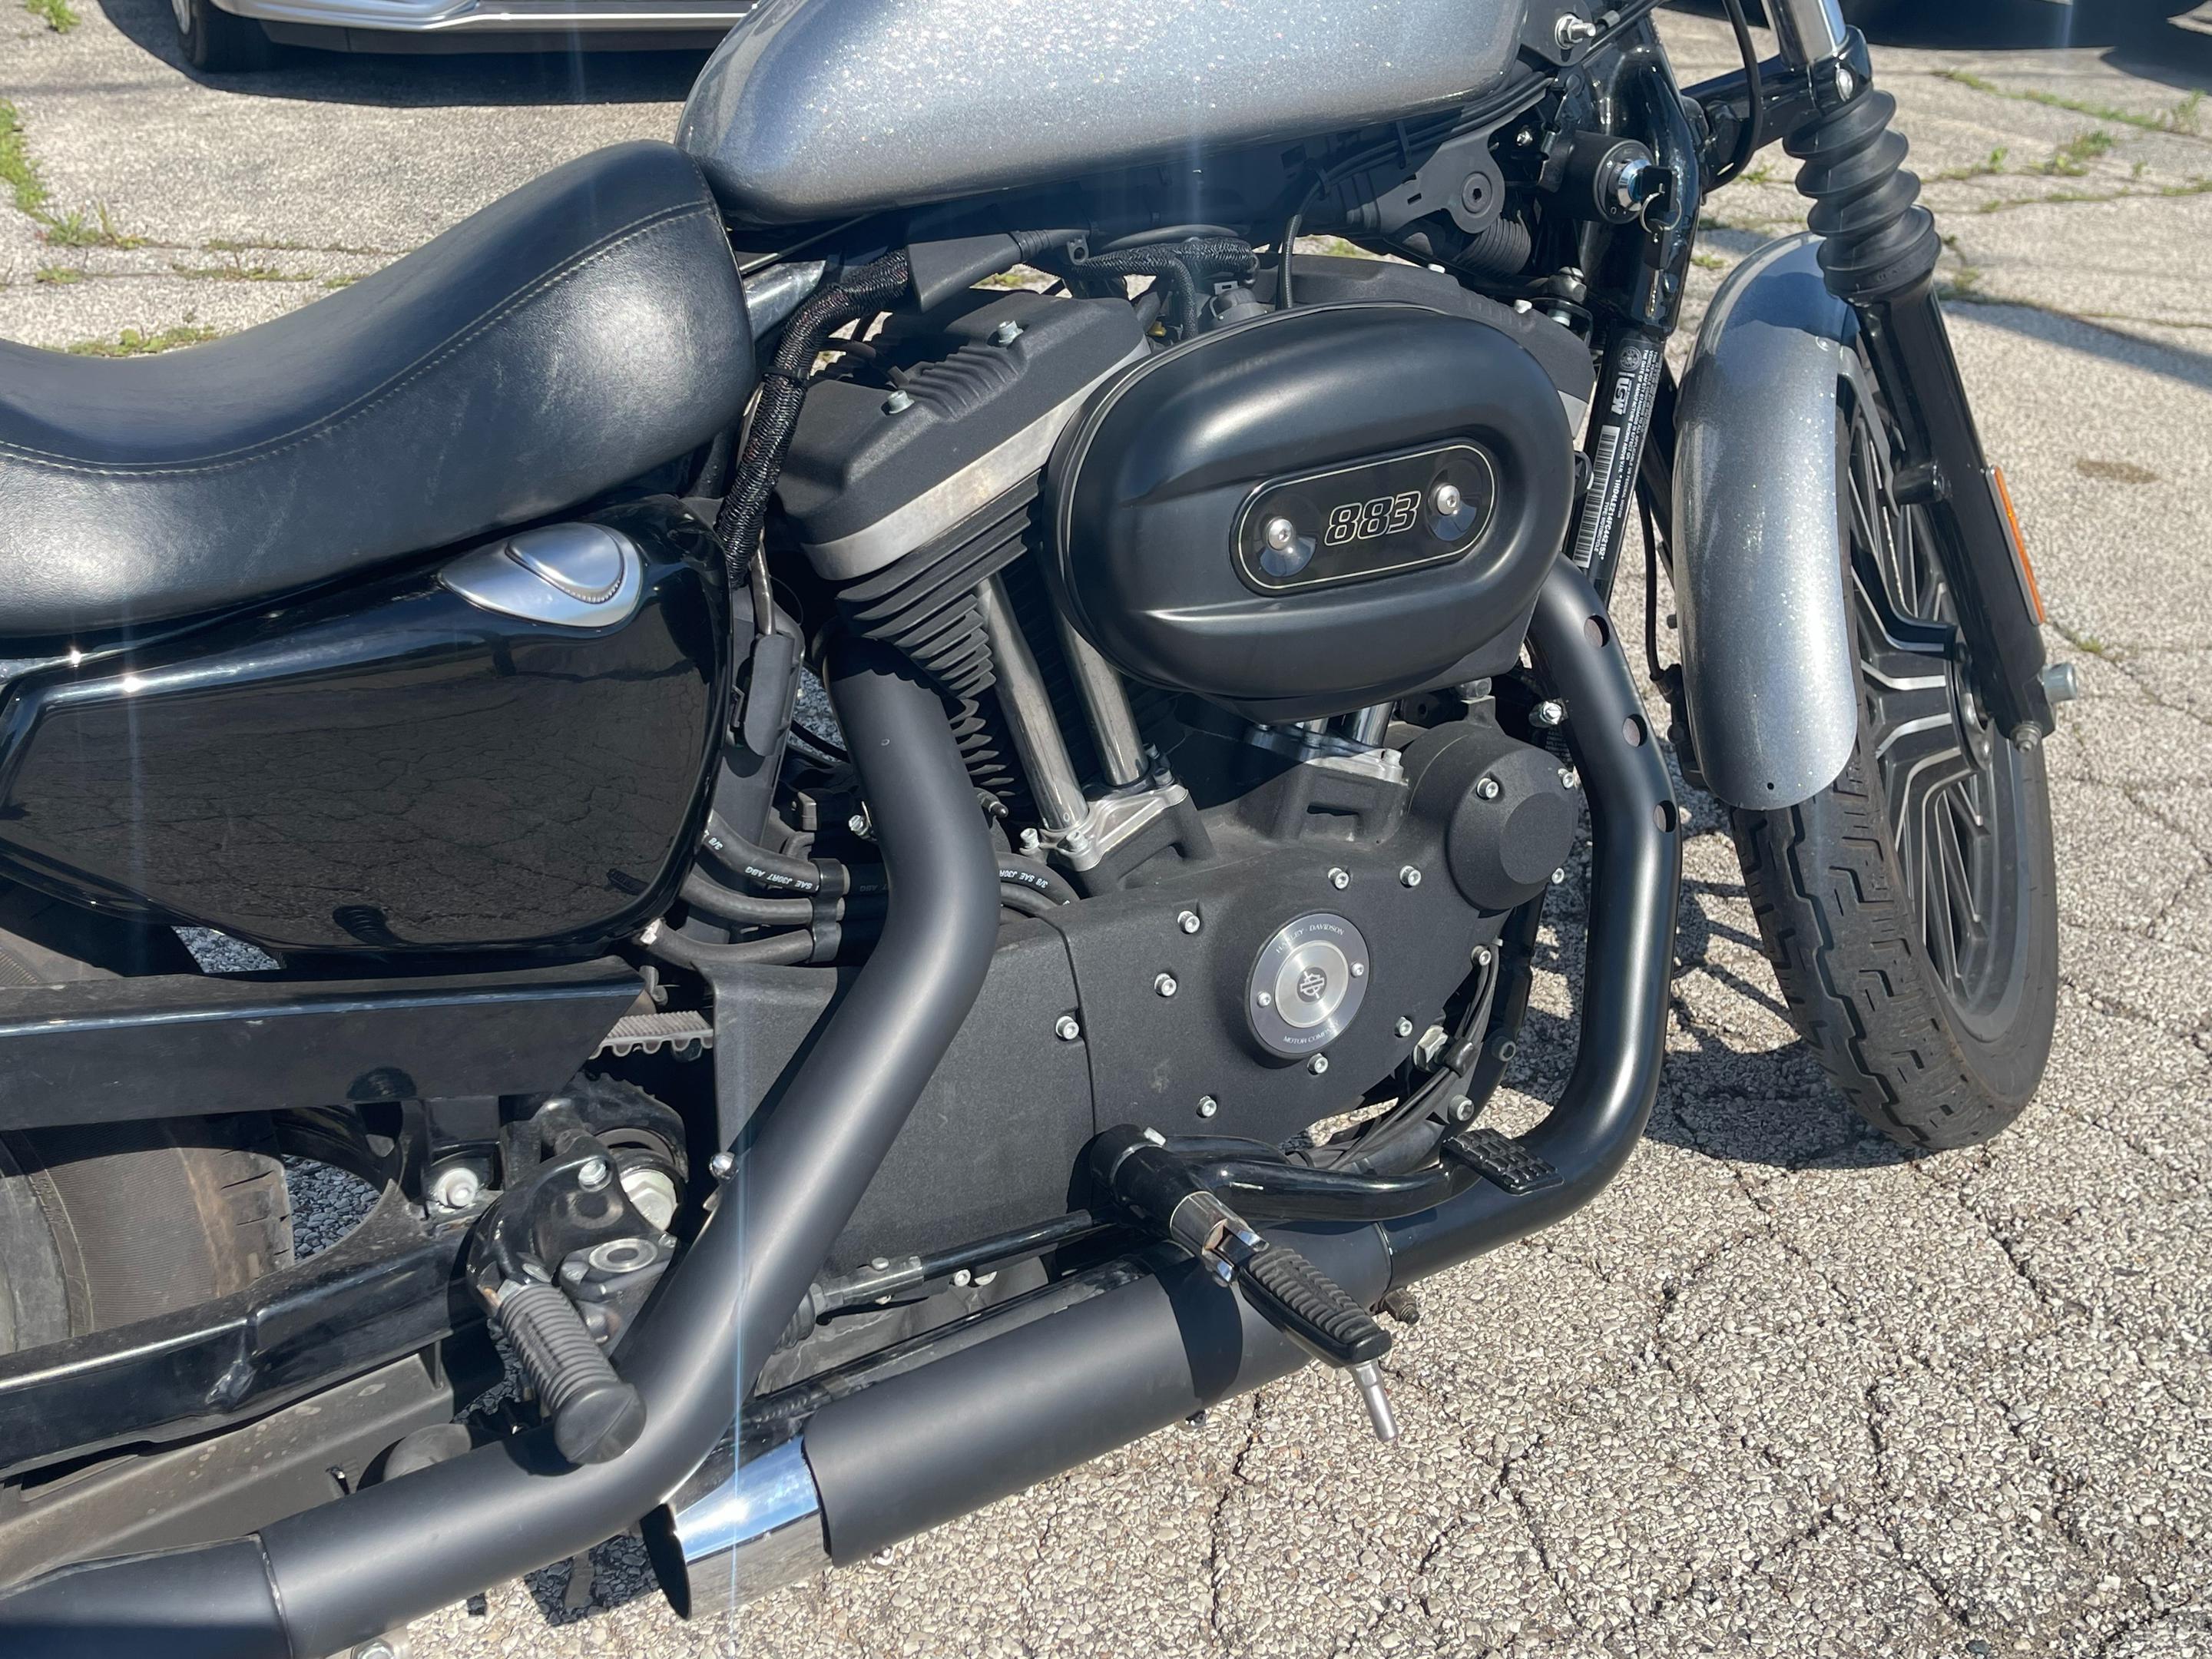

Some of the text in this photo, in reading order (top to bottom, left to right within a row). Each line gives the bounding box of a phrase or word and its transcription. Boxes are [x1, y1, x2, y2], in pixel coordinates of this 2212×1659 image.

[1324, 490, 1421, 546] 883
[1594, 517, 1606, 551] MOTORCYCLE
[708, 837, 724, 850] 3/8
[767, 873, 793, 885] J30R7
[1018, 872, 1035, 882] SAE
[794, 879, 813, 890] SAE
[1035, 878, 1048, 889] 3/8
[1275, 923, 1344, 953] HALEY DAVIDSON
[1283, 1035, 1307, 1045] MOTOR
